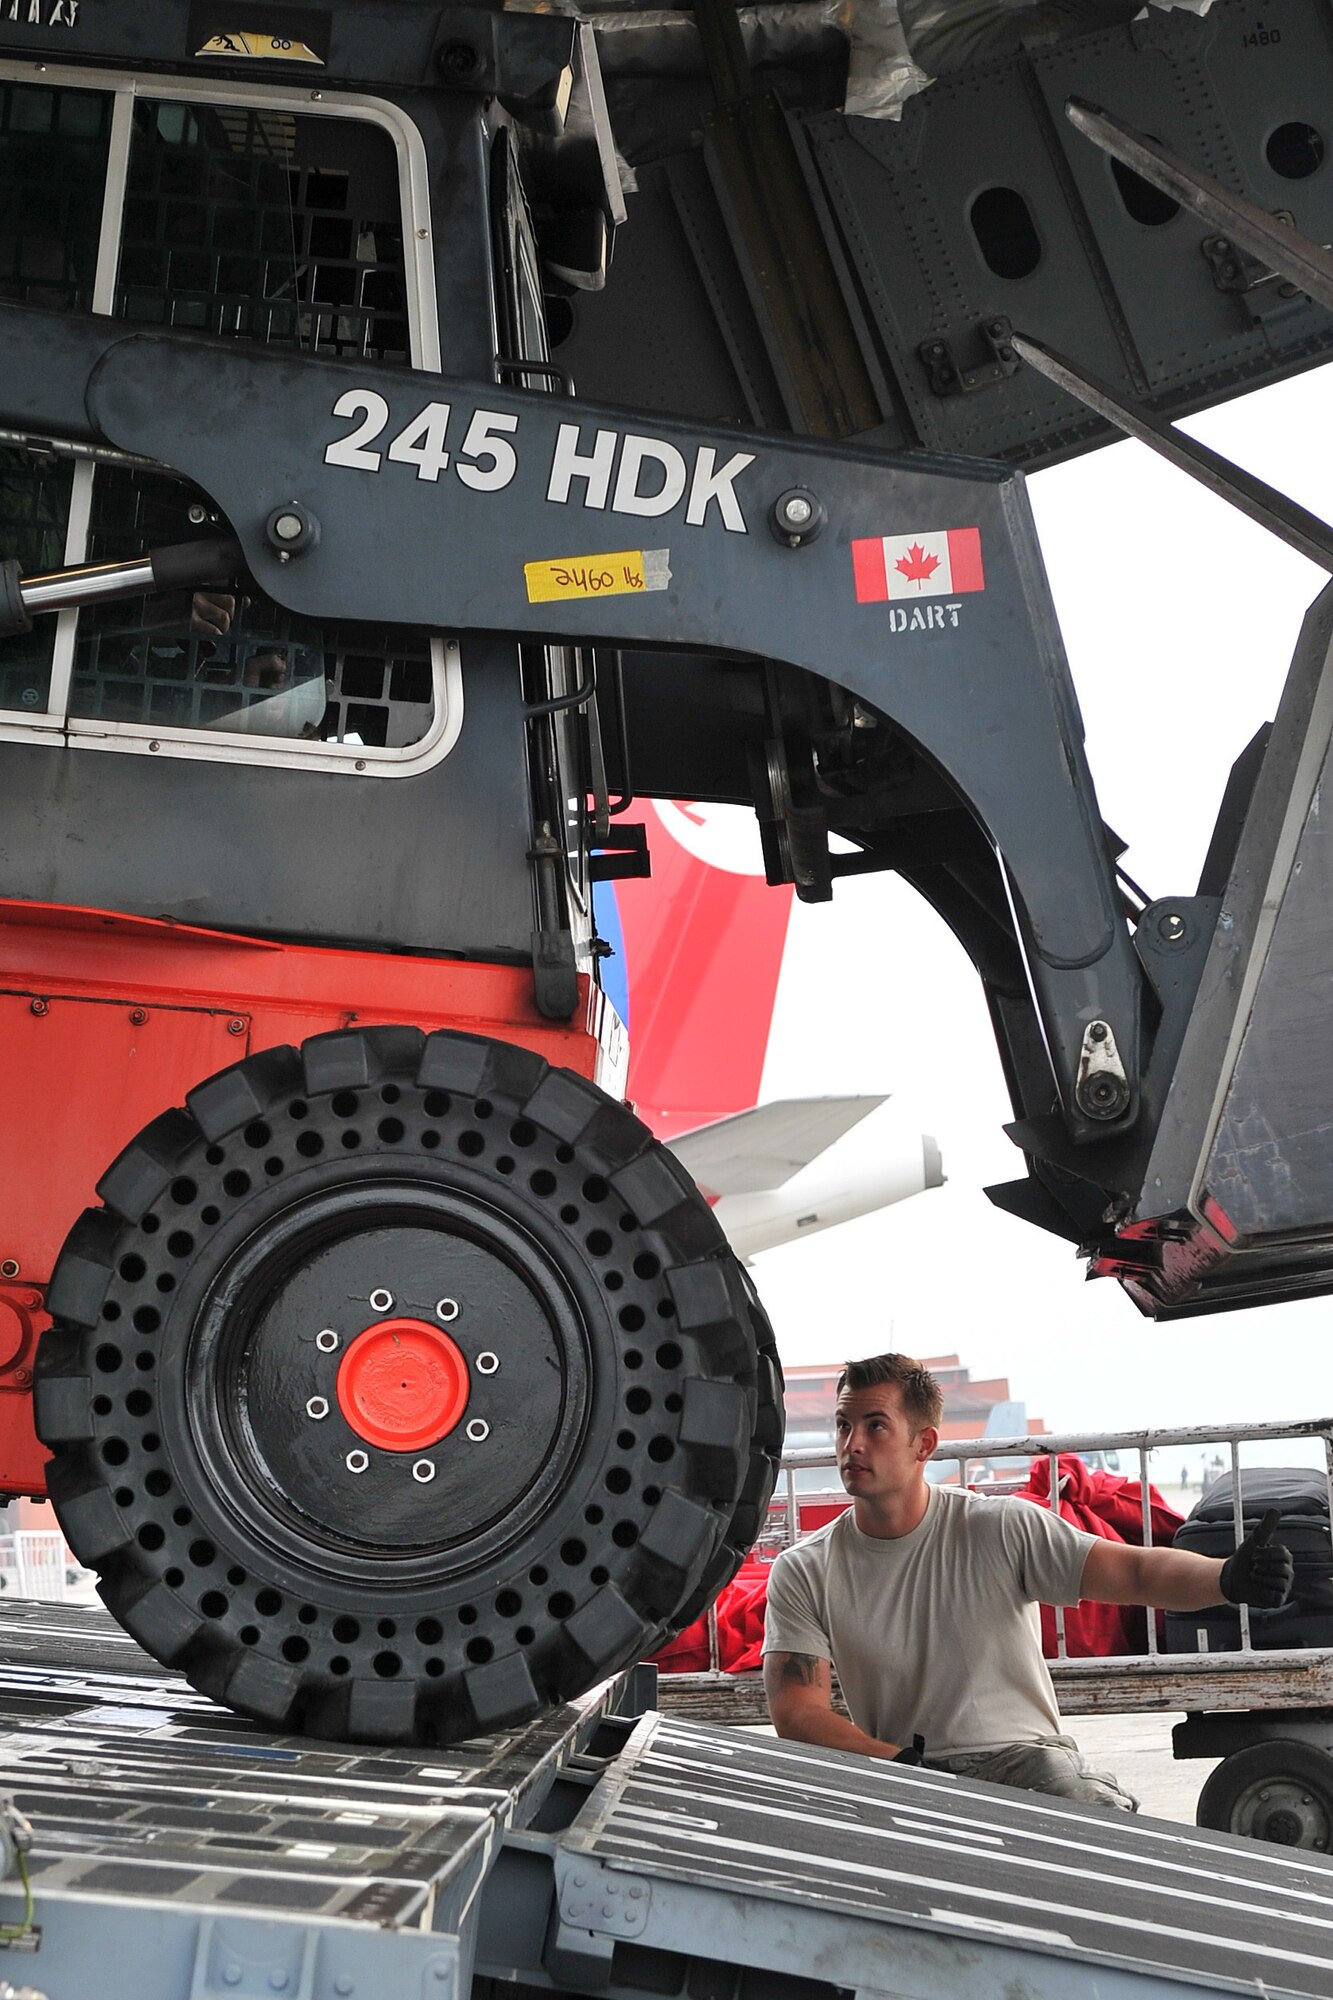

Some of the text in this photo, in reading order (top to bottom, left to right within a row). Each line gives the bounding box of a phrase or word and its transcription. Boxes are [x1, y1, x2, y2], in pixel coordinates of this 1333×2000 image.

[1243, 29, 1281, 48] 1480
[323, 388, 757, 534] 245 HDK
[550, 566, 643, 592] 2460 lbs
[889, 603, 962, 633] DART
